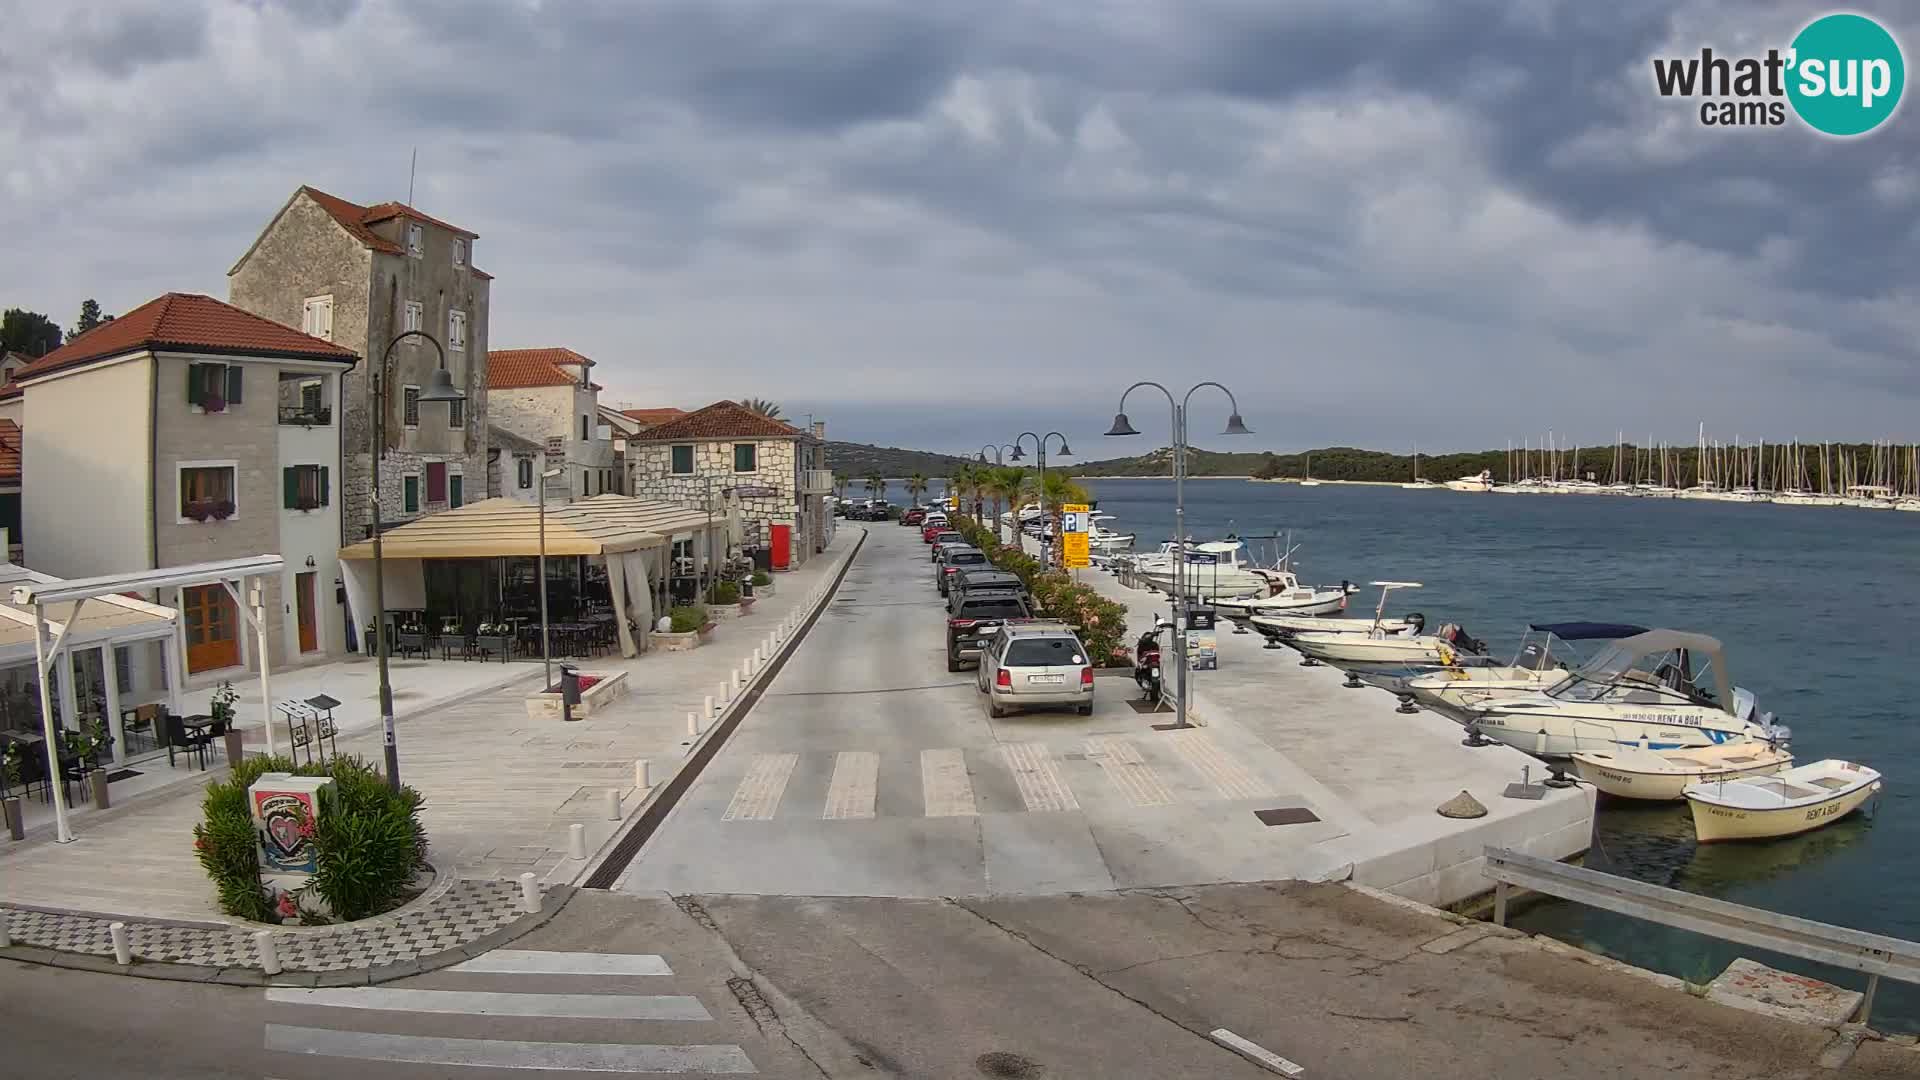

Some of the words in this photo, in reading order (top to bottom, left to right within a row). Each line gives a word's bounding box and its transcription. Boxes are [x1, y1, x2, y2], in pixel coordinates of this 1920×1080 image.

[1065, 514, 1076, 531] P
[1657, 713, 1677, 725] RENT
[1679, 714, 1684, 724] A
[1684, 715, 1703, 727] BOAT
[1806, 807, 1822, 820] RENT
[1827, 801, 1840, 816] BOAT
